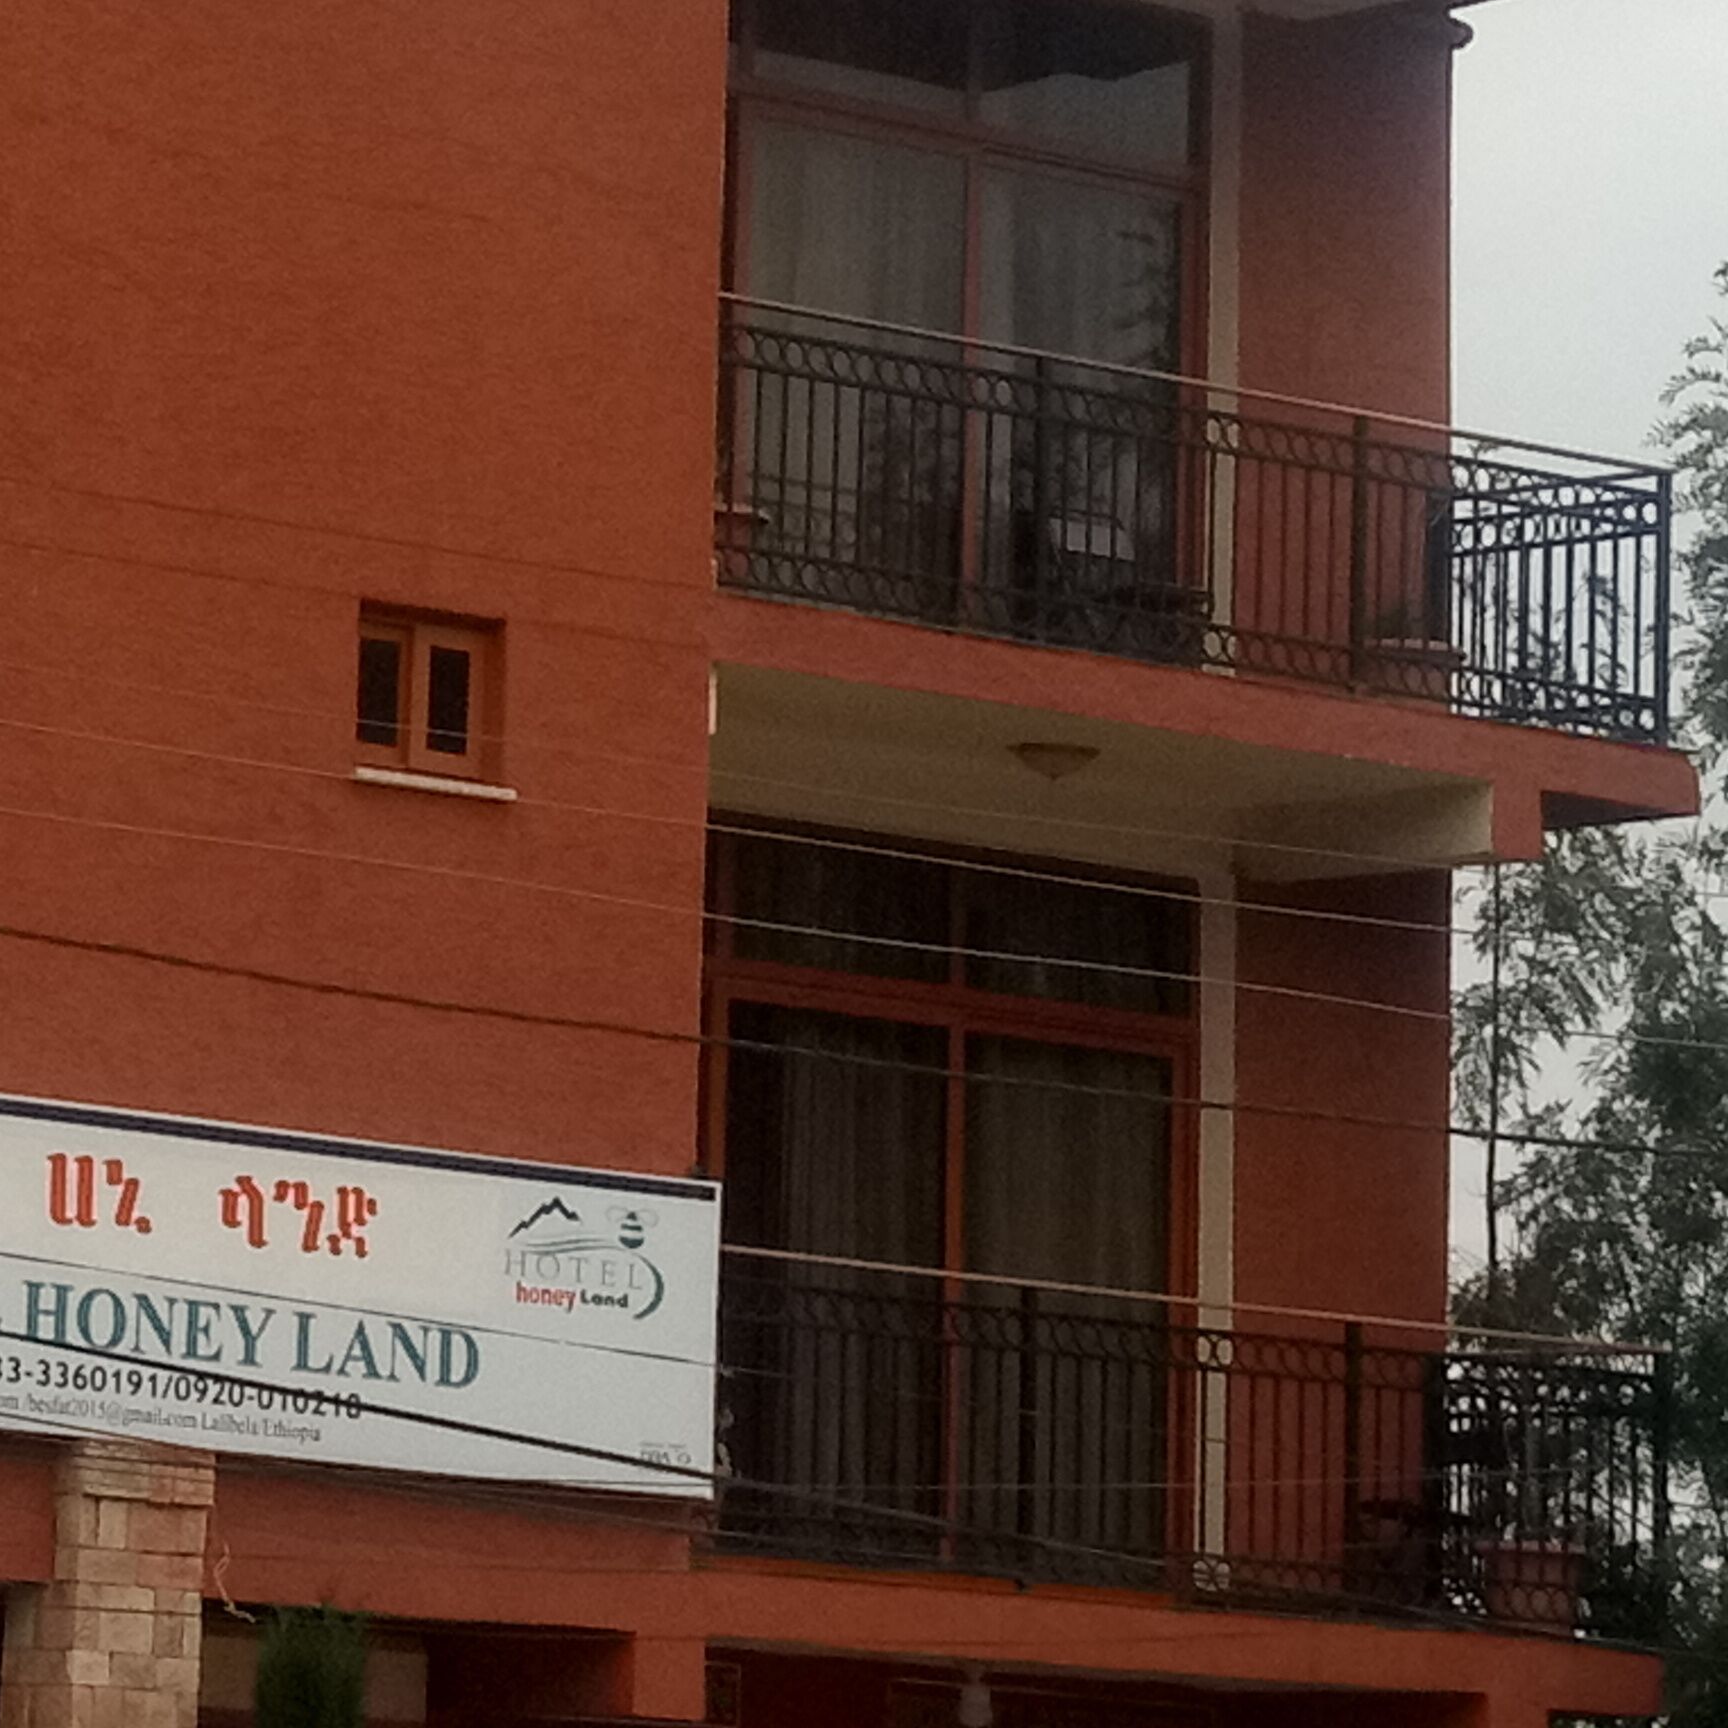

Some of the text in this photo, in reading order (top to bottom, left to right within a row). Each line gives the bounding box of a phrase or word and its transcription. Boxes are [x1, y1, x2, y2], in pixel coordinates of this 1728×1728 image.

[218, 1175, 377, 1258] ላንድ
[504, 1249, 643, 1290] HOTEL
[516, 1280, 576, 1314] honey
[24, 1279, 277, 1368] HONEY
[292, 1311, 481, 1389] LAND
